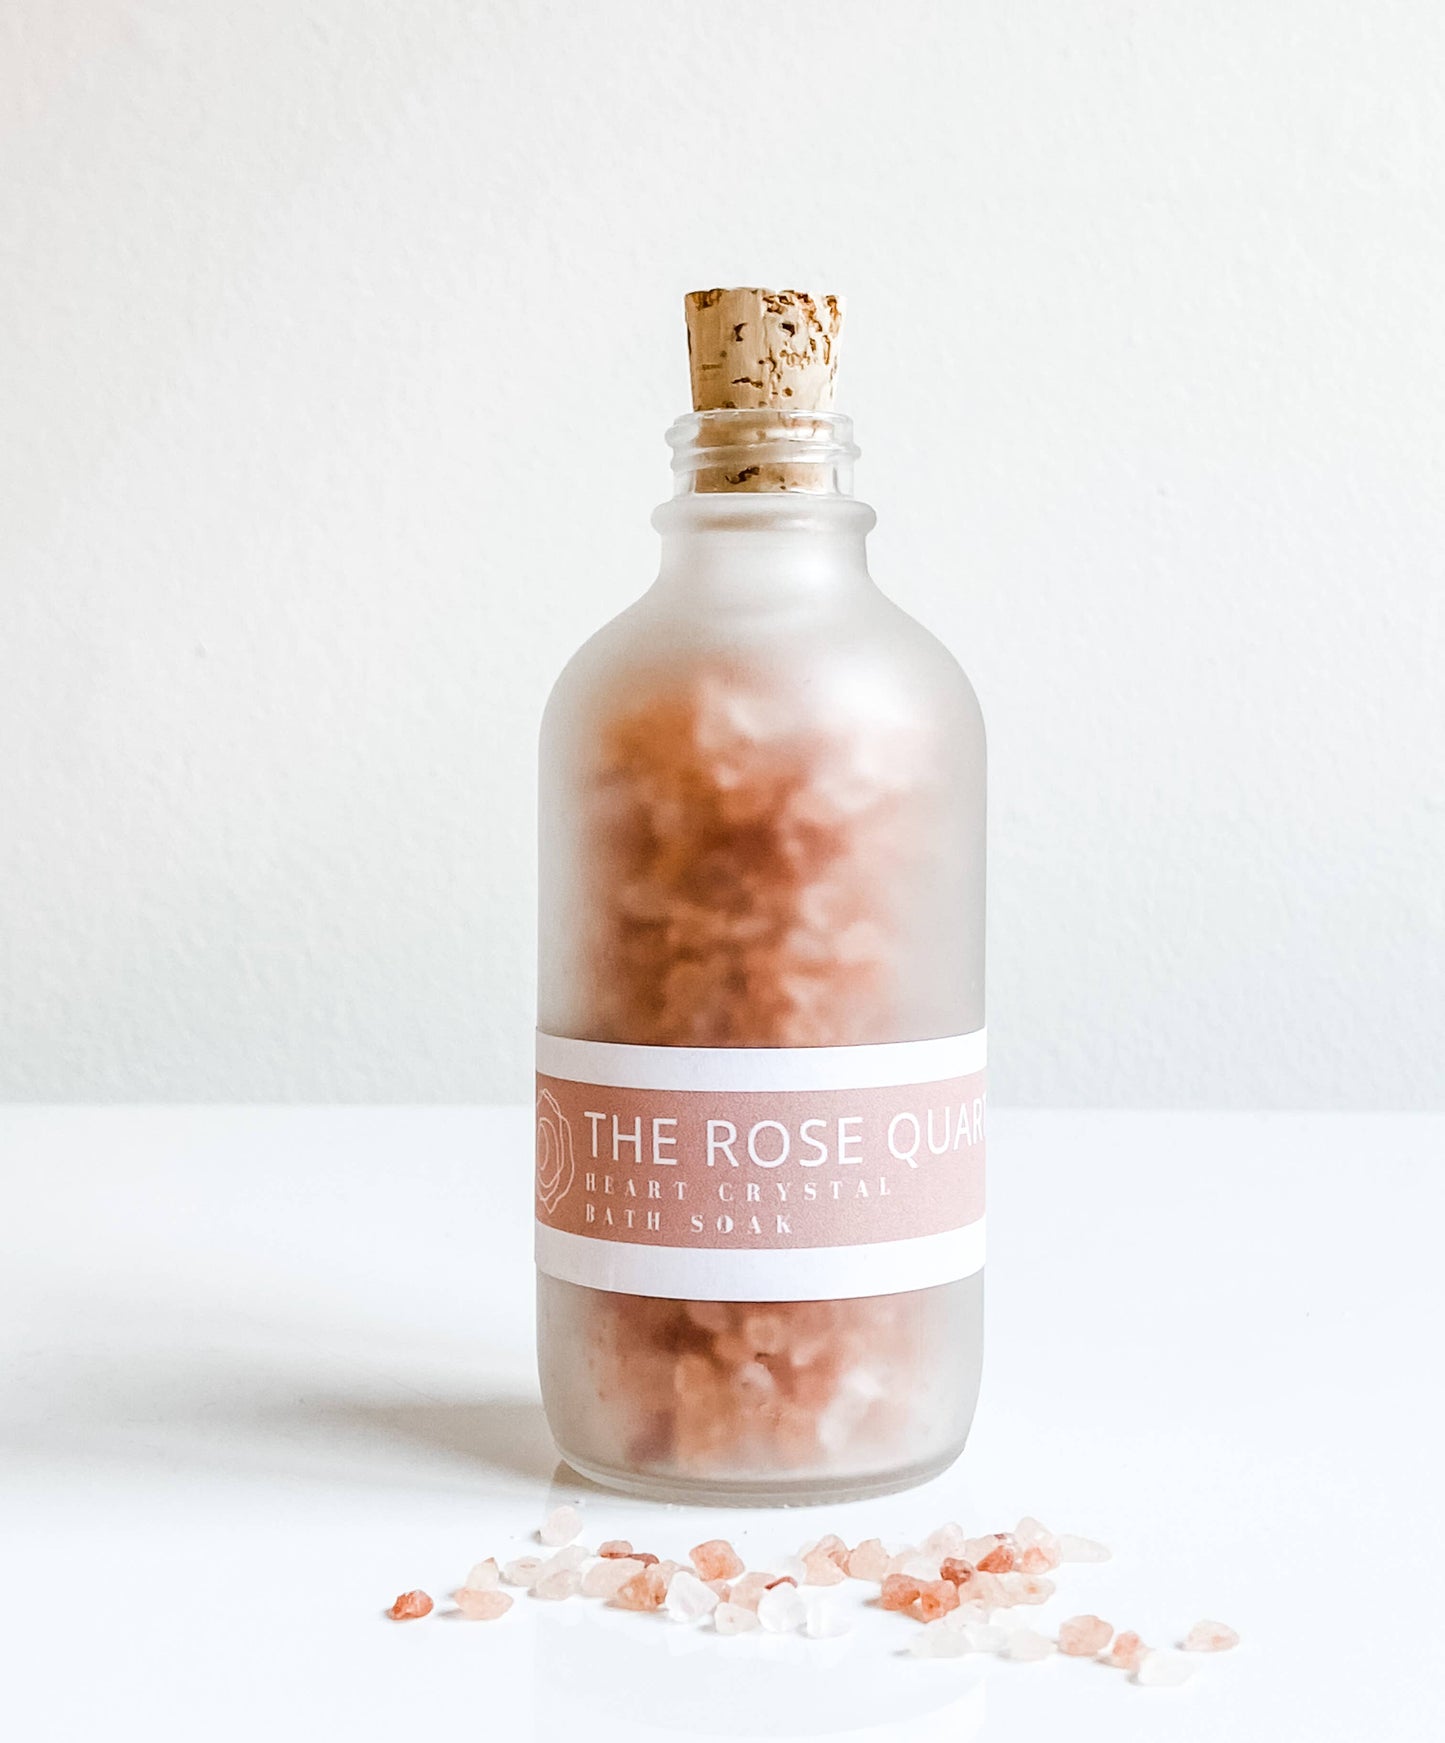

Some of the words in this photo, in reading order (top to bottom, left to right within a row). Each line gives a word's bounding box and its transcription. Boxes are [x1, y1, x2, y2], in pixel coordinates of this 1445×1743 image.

[584, 1111, 678, 1166] THE
[706, 1118, 864, 1168] ROSE
[585, 1173, 688, 1200] HEART
[718, 1177, 891, 1202] CRYSTAL
[585, 1203, 661, 1231] BATH
[690, 1214, 792, 1235] SOAK
